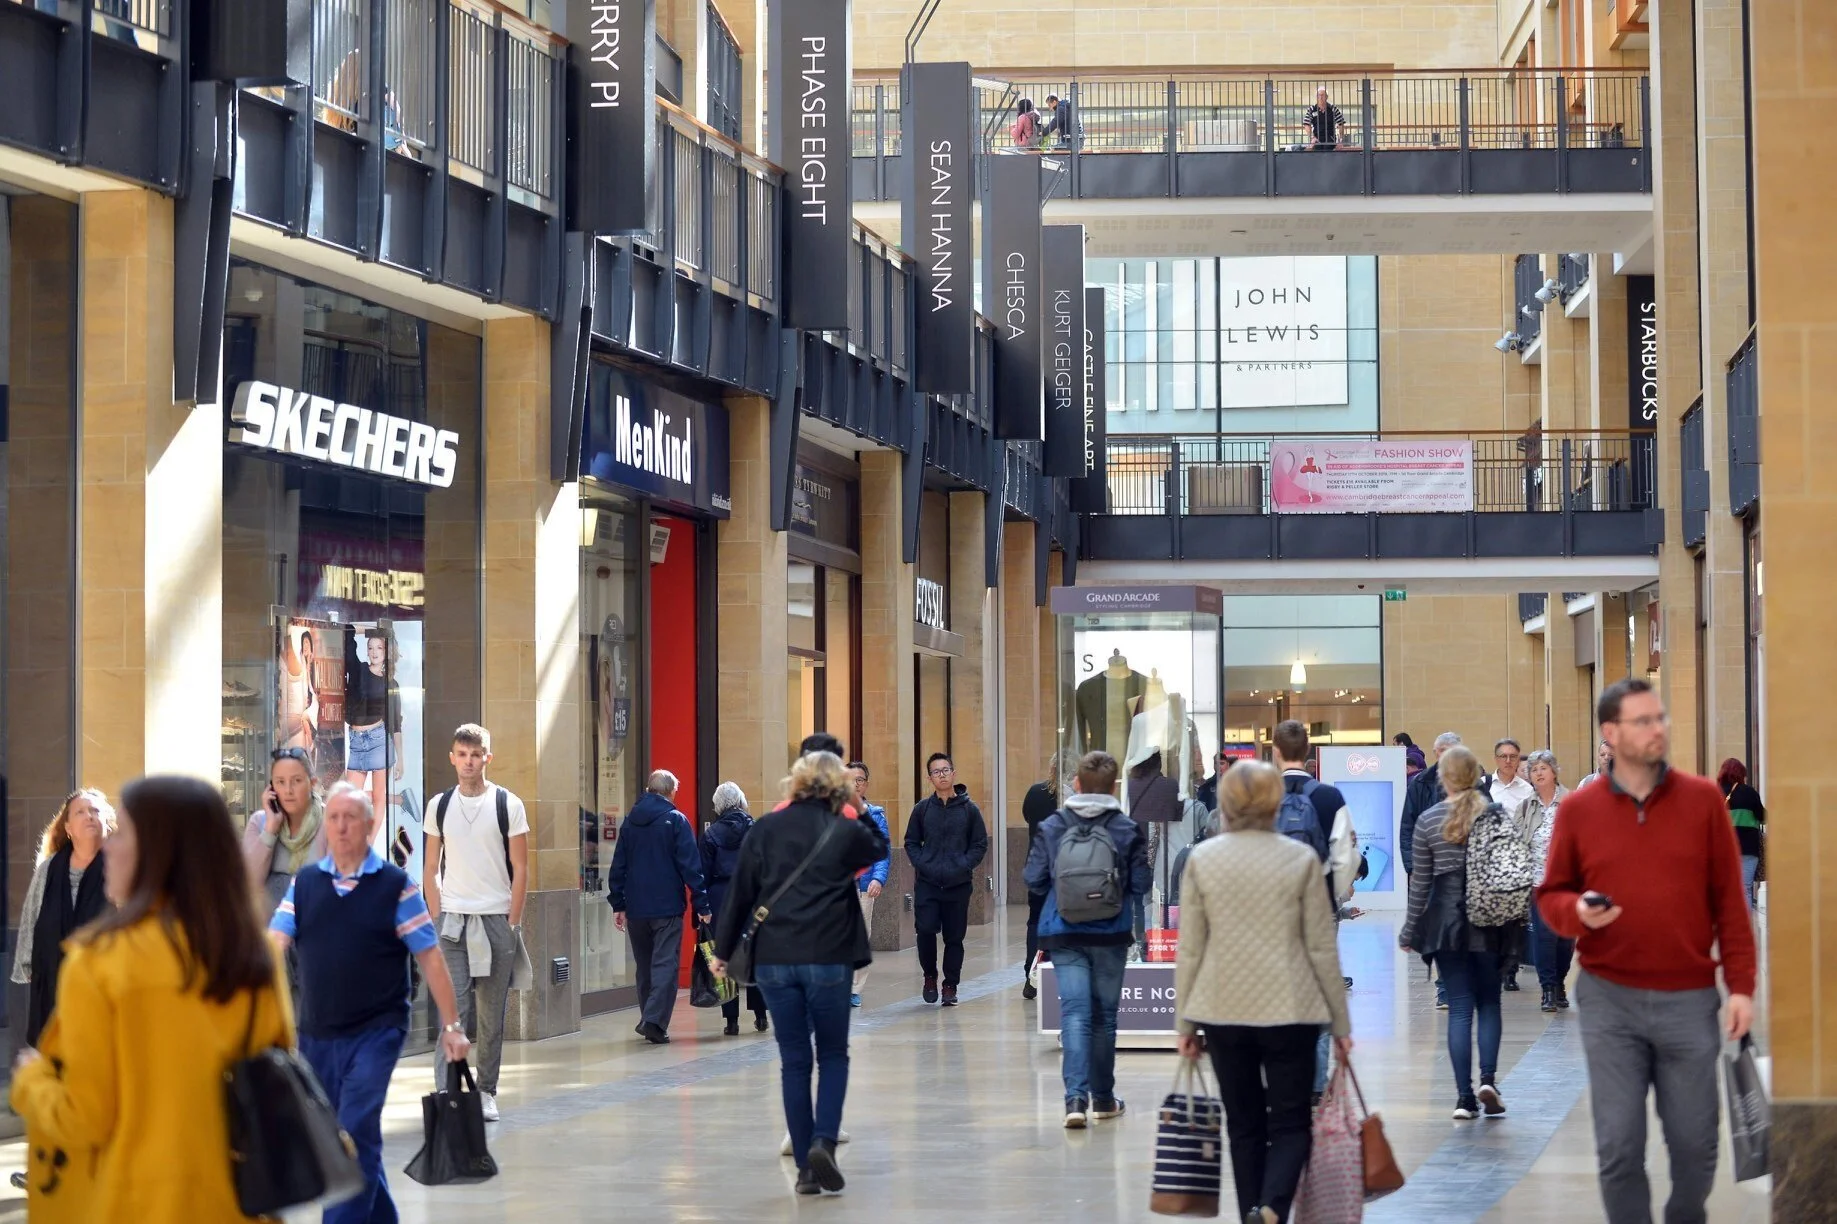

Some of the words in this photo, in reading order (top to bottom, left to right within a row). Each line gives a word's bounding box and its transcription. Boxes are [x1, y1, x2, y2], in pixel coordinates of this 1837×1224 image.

[590, 81, 620, 108] PI
[801, 36, 826, 129] PHASE
[801, 137, 827, 226] EIGHT
[930, 140, 952, 206] SEAN
[931, 213, 953, 313] HANNA
[1006, 252, 1025, 341] CHESCA
[1054, 289, 1071, 336] KURT
[1235, 286, 1312, 309] JOHN
[1228, 324, 1319, 344] LEWIS
[1640, 302, 1658, 421] STARBUCKS
[1054, 342, 1072, 411] GEIGER
[1236, 364, 1243, 372] &
[1248, 361, 1313, 372] PARTNERS
[230, 380, 460, 488] SKECHERS
[615, 394, 692, 485] MenKind
[1374, 449, 1425, 459] FASHION
[1428, 448, 1464, 458] SHOW
[1326, 493, 1465, 501] www.cambridgebreastcancerappeal.com
[915, 577, 945, 629] FOSSIL
[1086, 592, 1122, 603] GRAND
[1123, 592, 1160, 602] ARCADE
